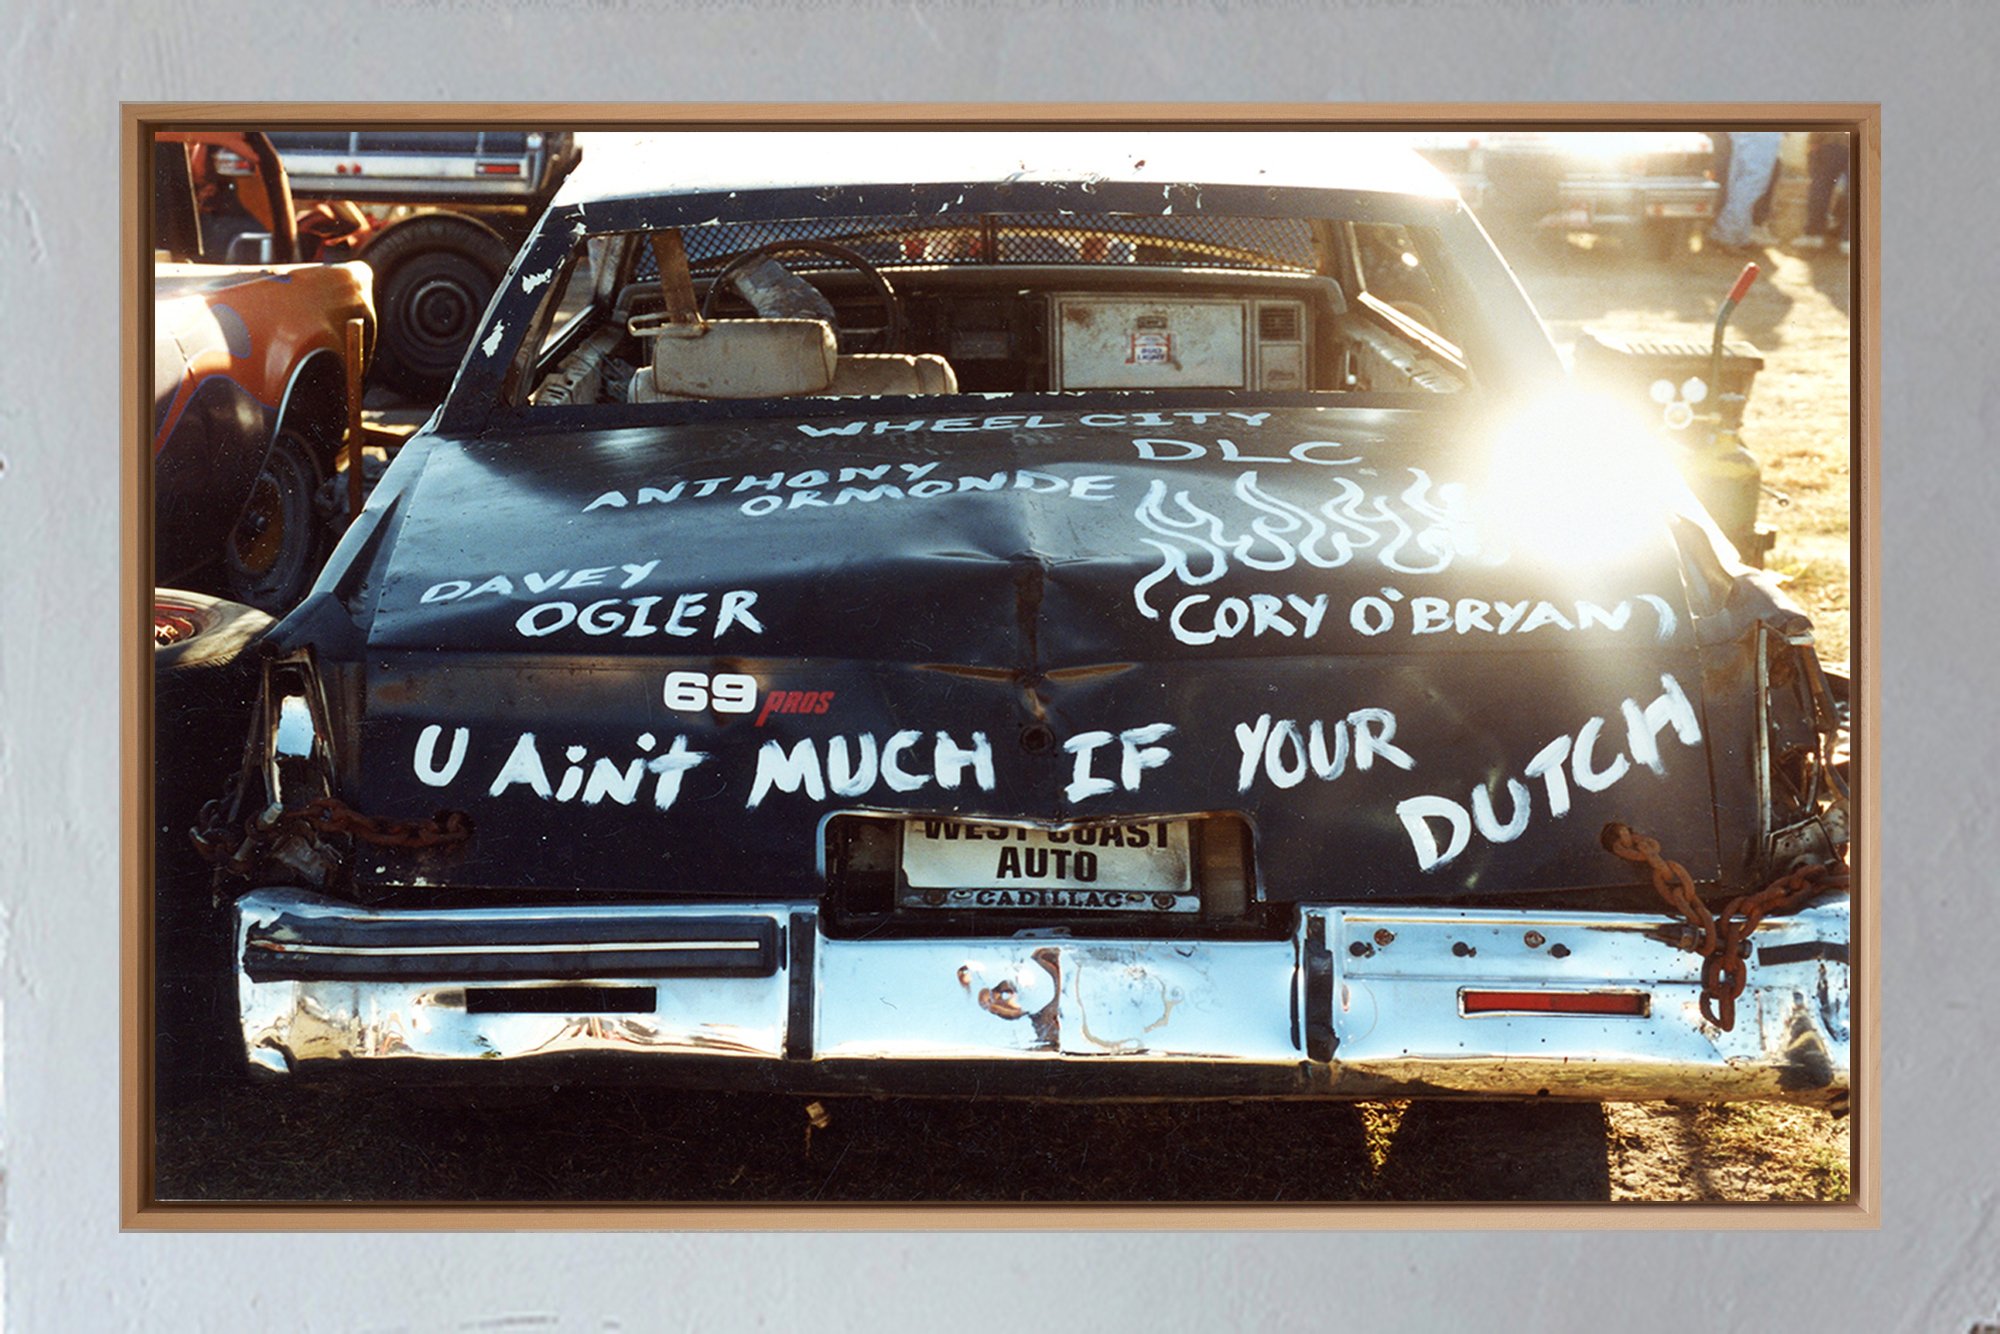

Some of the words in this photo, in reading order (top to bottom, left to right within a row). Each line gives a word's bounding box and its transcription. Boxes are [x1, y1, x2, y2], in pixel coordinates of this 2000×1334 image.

[797, 414, 1065, 437] WHEEL
[1079, 411, 1272, 429] CITY
[1133, 438, 1364, 464] DLC
[582, 461, 942, 514] ANTHONY
[741, 469, 1117, 516] ORMONDE
[420, 559, 662, 604] DAVEY
[514, 588, 765, 639] OGIER
[1169, 593, 1329, 645] CORY
[663, 671, 757, 713] 69
[413, 724, 470, 788] U
[745, 728, 996, 812] MUCH
[1062, 722, 1176, 804] IF
[1234, 707, 1418, 794] YOUR
[1395, 673, 1704, 873] DUTCH
[996, 847, 1098, 882] AUTO
[976, 889, 1123, 908] CADILLAC
